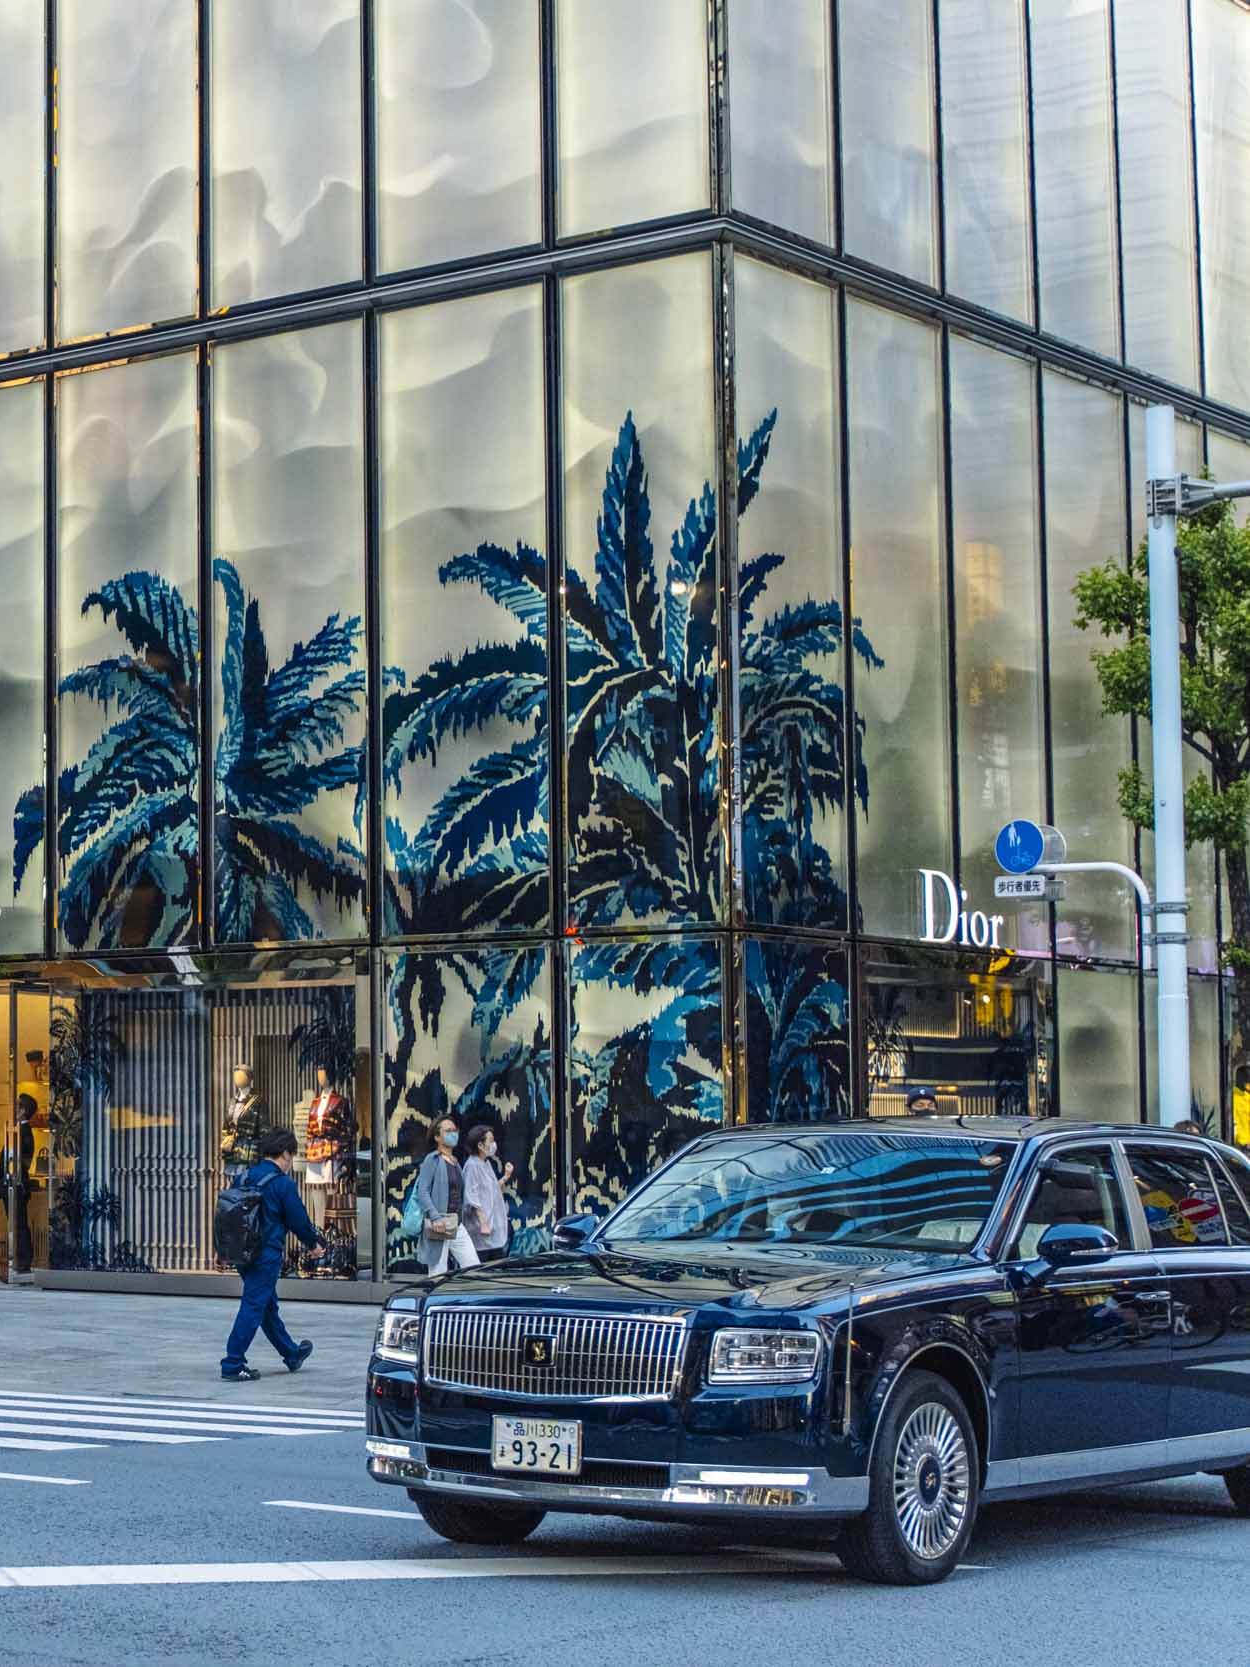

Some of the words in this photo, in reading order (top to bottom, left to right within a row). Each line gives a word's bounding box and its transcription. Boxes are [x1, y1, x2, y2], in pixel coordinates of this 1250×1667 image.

[998, 880, 1040, 894] 歩行者優先
[918, 868, 1004, 949] Dior
[512, 1440, 572, 1470] 93-21
